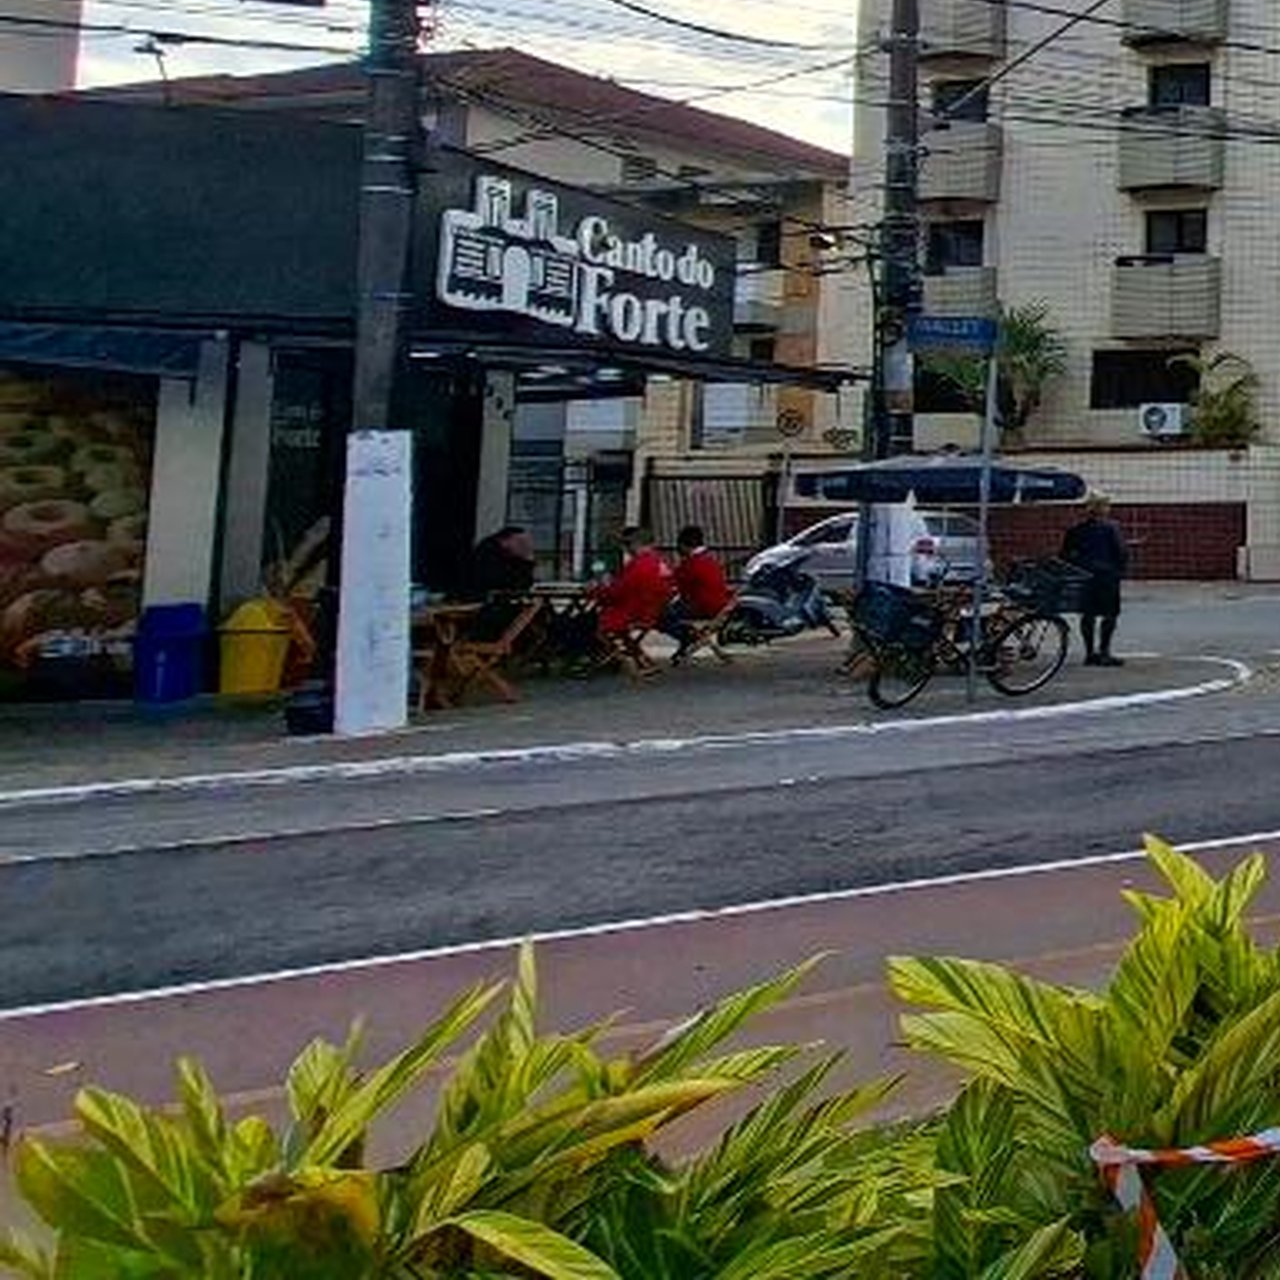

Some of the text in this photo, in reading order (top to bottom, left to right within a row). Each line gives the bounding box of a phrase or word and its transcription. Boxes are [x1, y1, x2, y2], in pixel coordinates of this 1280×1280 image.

[576, 216, 714, 289] Canto do
[574, 261, 711, 351] Forte
